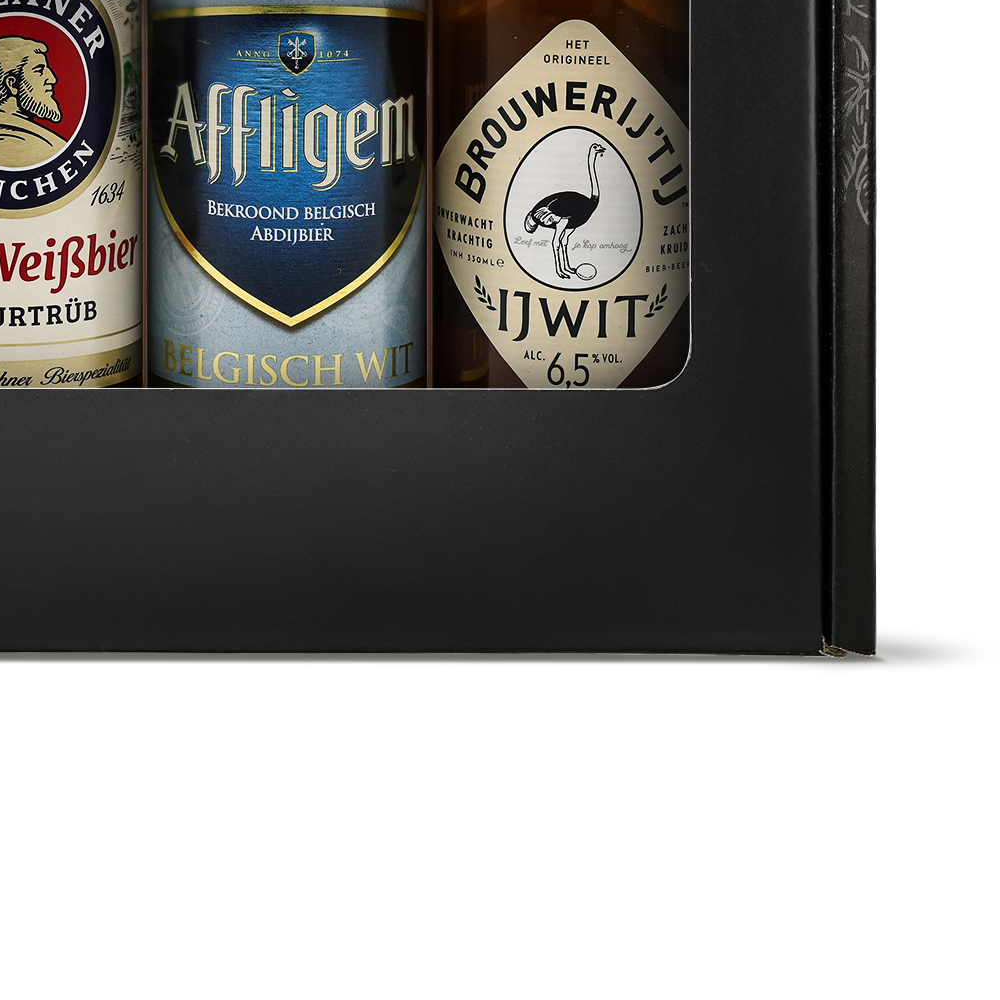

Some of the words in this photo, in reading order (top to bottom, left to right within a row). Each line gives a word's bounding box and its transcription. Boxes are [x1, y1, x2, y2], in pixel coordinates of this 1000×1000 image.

[236, 50, 271, 58] ANNO
[319, 50, 349, 58] 1074
[565, 40, 590, 50] HET
[543, 54, 610, 66] ORIGINEEL
[160, 81, 417, 191] Affligem
[90, 180, 125, 208] 1634
[207, 200, 299, 221] BEKROOND
[304, 202, 376, 219] BELGISCH
[436, 205, 494, 231] ONVERWACHT
[250, 225, 334, 247] ABDIJBIER
[446, 227, 493, 249] KRACHTIG
[513, 236, 533, 248] Leef
[571, 241, 582, 250] je
[598, 240, 632, 254] omhoog
[450, 249, 463, 259] INH
[498, 288, 650, 342] IJWIT
[39, 355, 133, 387] Bierspezialität
[162, 339, 344, 389] BELGISCH
[353, 341, 414, 387] WIT
[523, 350, 546, 361] ALC.
[547, 352, 590, 388] 6,5
[601, 353, 622, 363] VOL.
